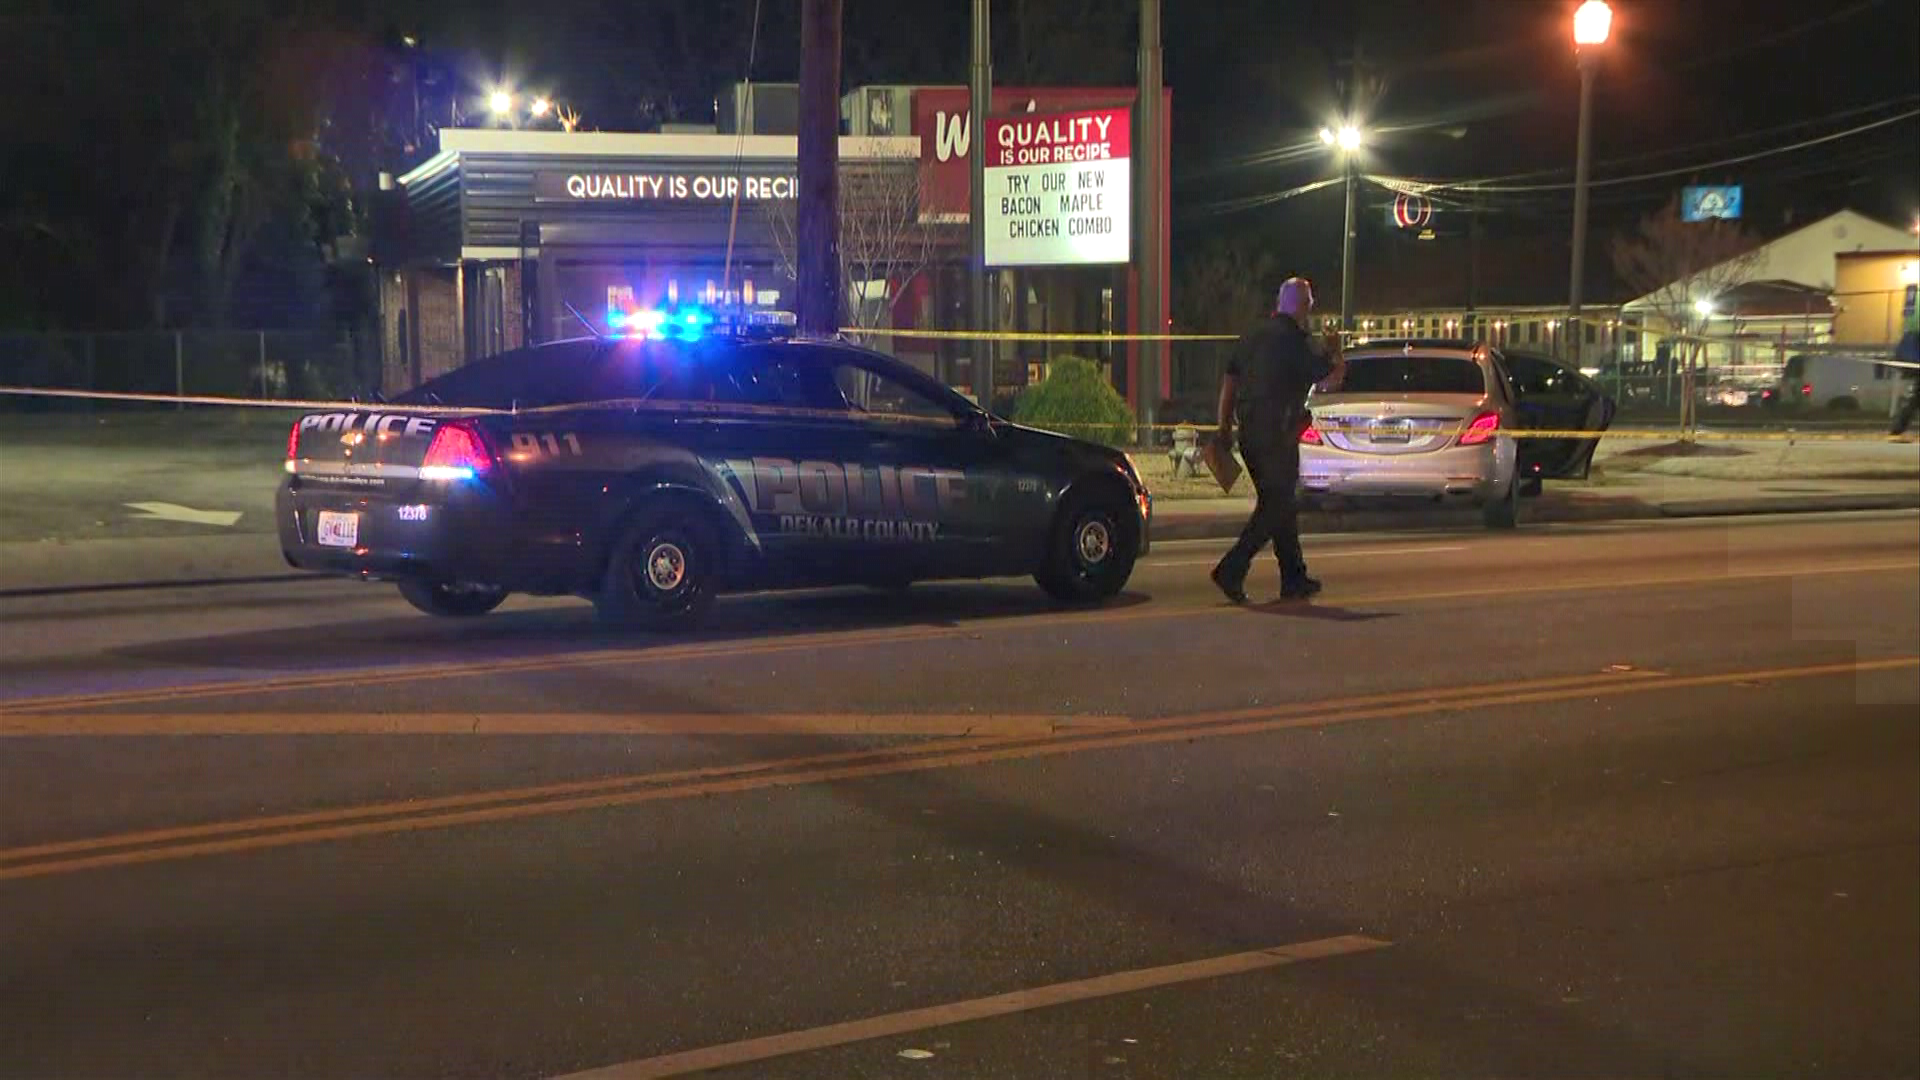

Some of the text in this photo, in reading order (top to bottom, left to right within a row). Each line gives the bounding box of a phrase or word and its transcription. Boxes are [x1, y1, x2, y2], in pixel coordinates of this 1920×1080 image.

[998, 115, 1112, 148] QUALITY
[1000, 143, 1111, 165] IS OUR RECIPE
[567, 175, 799, 199] QUALITY IS OUR RECI
[1007, 170, 1105, 194] TRY OUR NEW
[1001, 193, 1103, 216] BACON MAPLE
[1009, 216, 1112, 238] CHICKEN COMBO
[300, 411, 437, 437] POLICE
[511, 433, 583, 457] 911
[752, 456, 967, 516] POLICE
[397, 503, 427, 521] 12378
[780, 513, 939, 543] DEKALB COUNTY
